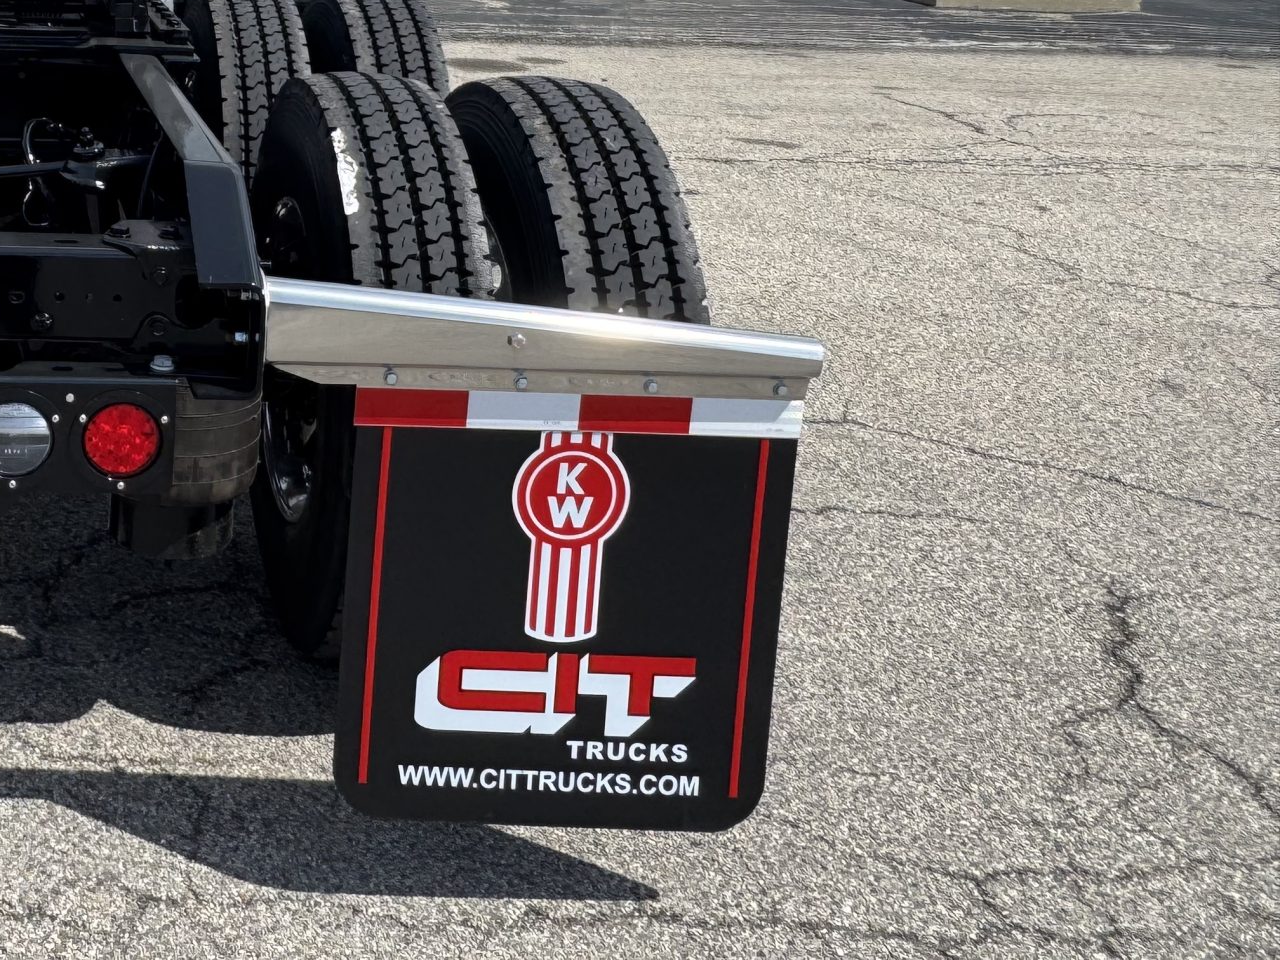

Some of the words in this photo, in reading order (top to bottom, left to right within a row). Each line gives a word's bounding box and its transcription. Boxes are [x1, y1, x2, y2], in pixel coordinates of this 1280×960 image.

[556, 462, 588, 495] K
[547, 496, 594, 528] W
[414, 649, 697, 738] CIT
[566, 740, 689, 763] TRUCKS
[398, 764, 700, 798] WWW.CITTRUCKS.COM
